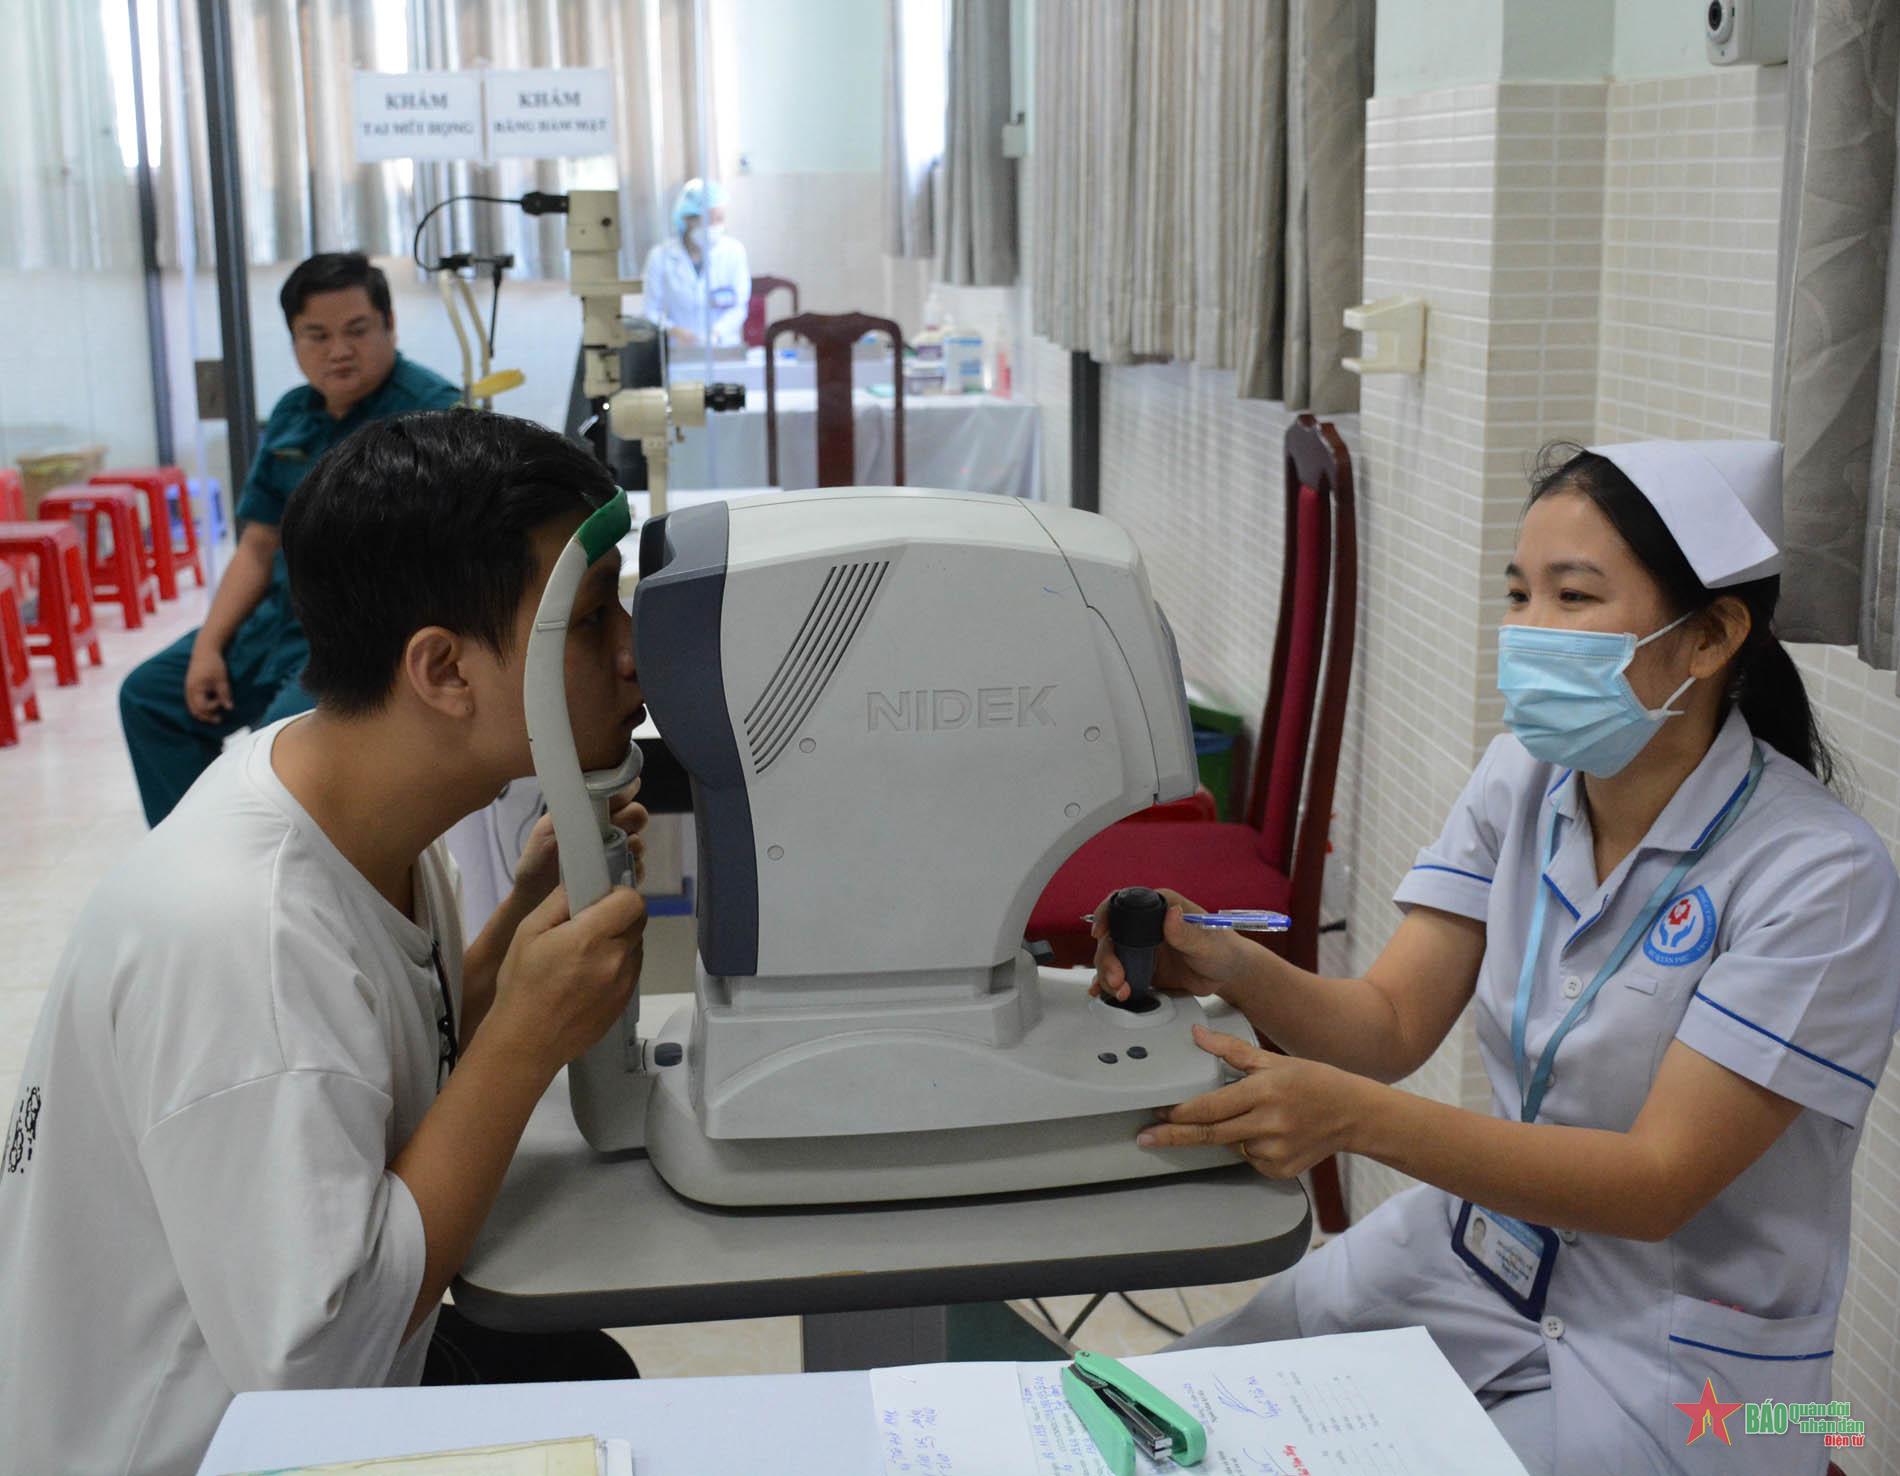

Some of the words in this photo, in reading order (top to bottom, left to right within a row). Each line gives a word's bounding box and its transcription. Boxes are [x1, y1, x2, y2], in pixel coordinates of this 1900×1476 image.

[385, 89, 448, 110] KHÁM
[518, 87, 581, 108] KHÁM
[866, 684, 1059, 732] NIDEK
